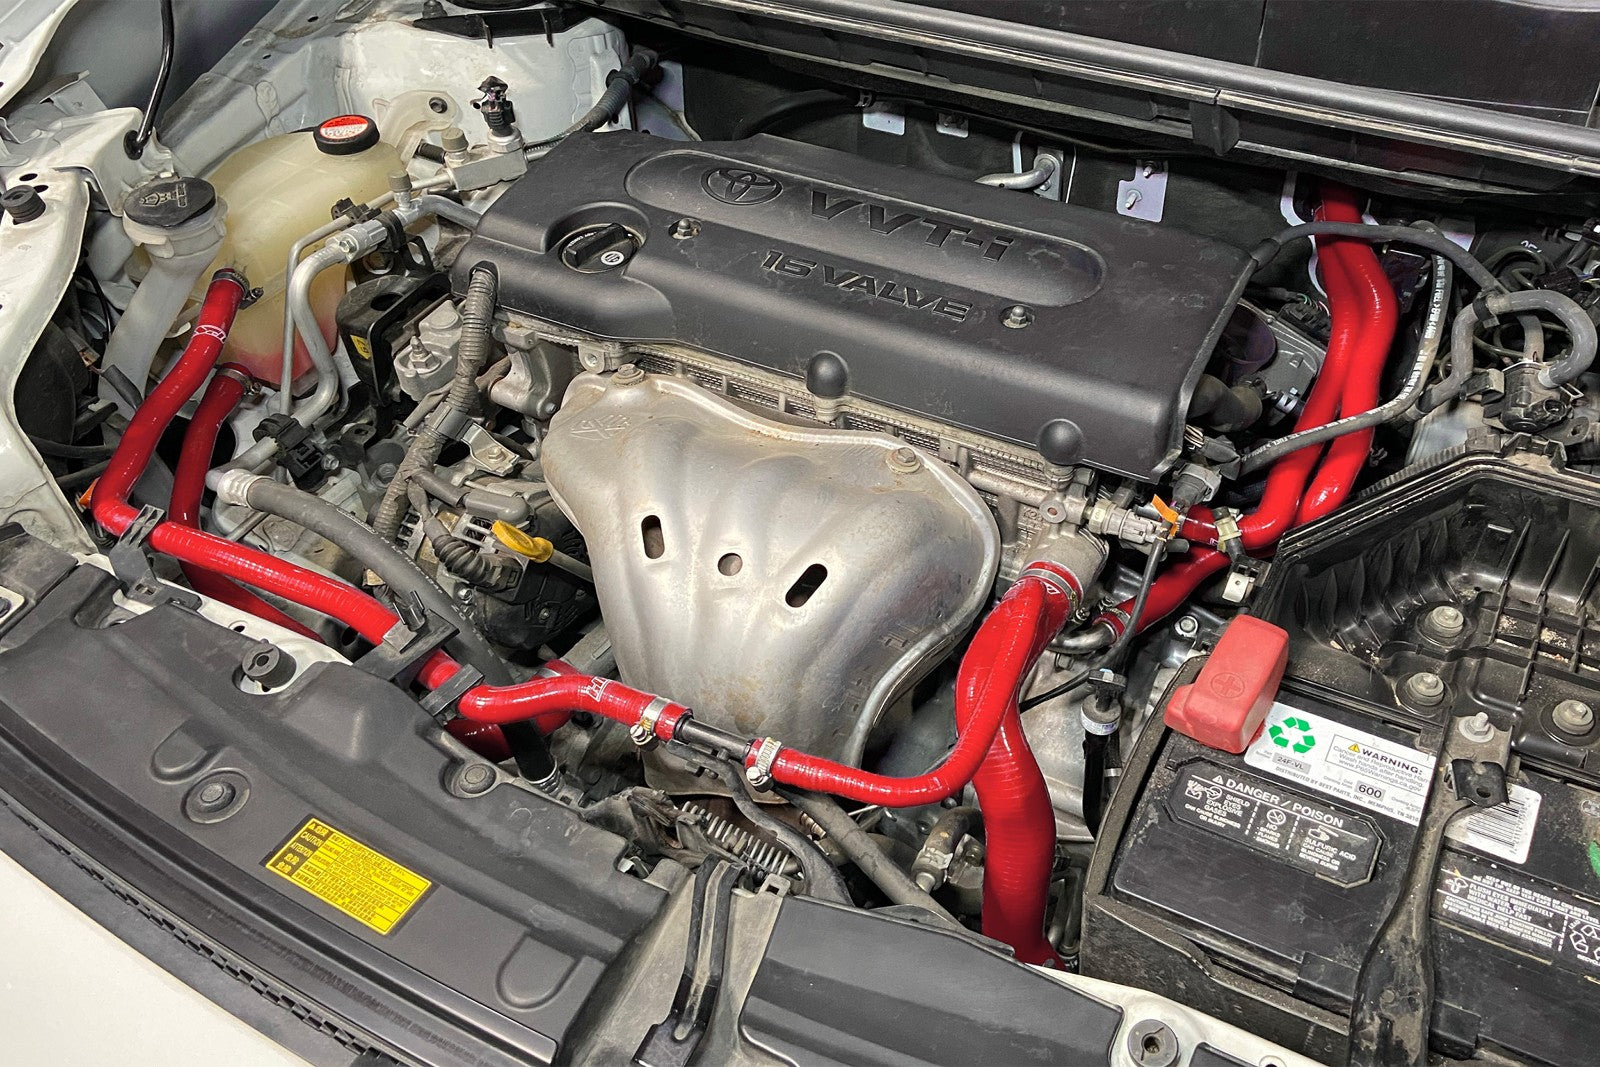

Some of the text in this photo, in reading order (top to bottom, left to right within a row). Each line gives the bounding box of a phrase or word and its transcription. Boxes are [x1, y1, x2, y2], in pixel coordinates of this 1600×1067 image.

[811, 190, 1014, 262] VVT-i
[761, 250, 973, 322] 16 VALVE
[1362, 749, 1422, 775] WARNING:
[1226, 793, 1250, 807] SHIELD
[1358, 783, 1382, 799] 600
[1204, 804, 1228, 817] GASES
[1206, 799, 1243, 817] EXPLOSIVE
[1224, 799, 1242, 810] EYES
[1226, 779, 1280, 806] DANGER
[1293, 802, 1344, 829] POISON
[1266, 823, 1277, 831] NO
[1304, 837, 1356, 861] SULFURIC ACID
[1468, 889, 1485, 900] WITH
[1513, 905, 1527, 915] GET
[1470, 883, 1554, 919] FLUSH EYES IMMEDIATELY
[1515, 911, 1532, 922] FAST
